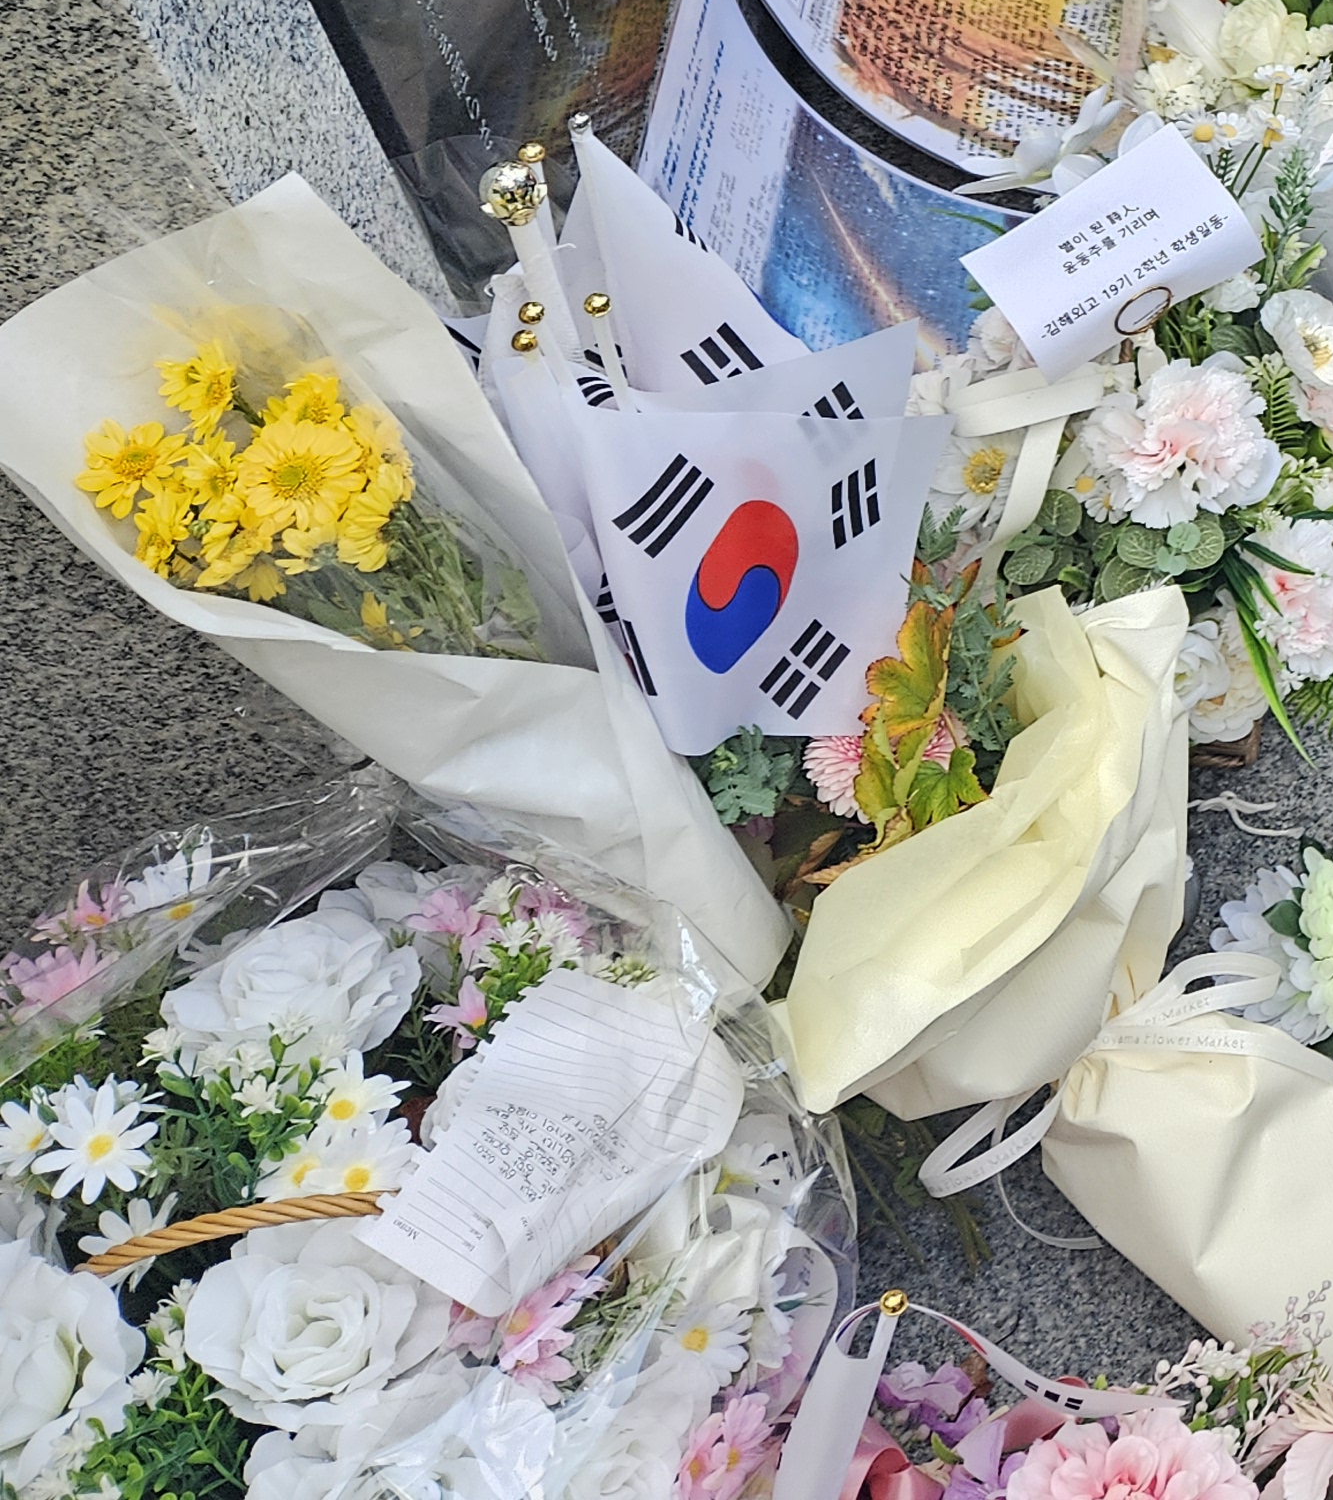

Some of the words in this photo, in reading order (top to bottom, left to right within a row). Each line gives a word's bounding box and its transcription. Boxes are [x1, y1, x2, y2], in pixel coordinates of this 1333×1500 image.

[1057, 232, 1089, 255] 별이
[1089, 220, 1106, 236] 된
[1062, 235, 1118, 276] 윤동주를
[1119, 207, 1160, 240] 기리며
[1040, 295, 1101, 340] -김해외고
[1101, 273, 1134, 300] 19기
[1134, 249, 1172, 281] 2학년
[1170, 212, 1230, 255] 학생일동-
[1197, 1034, 1246, 1050] Market
